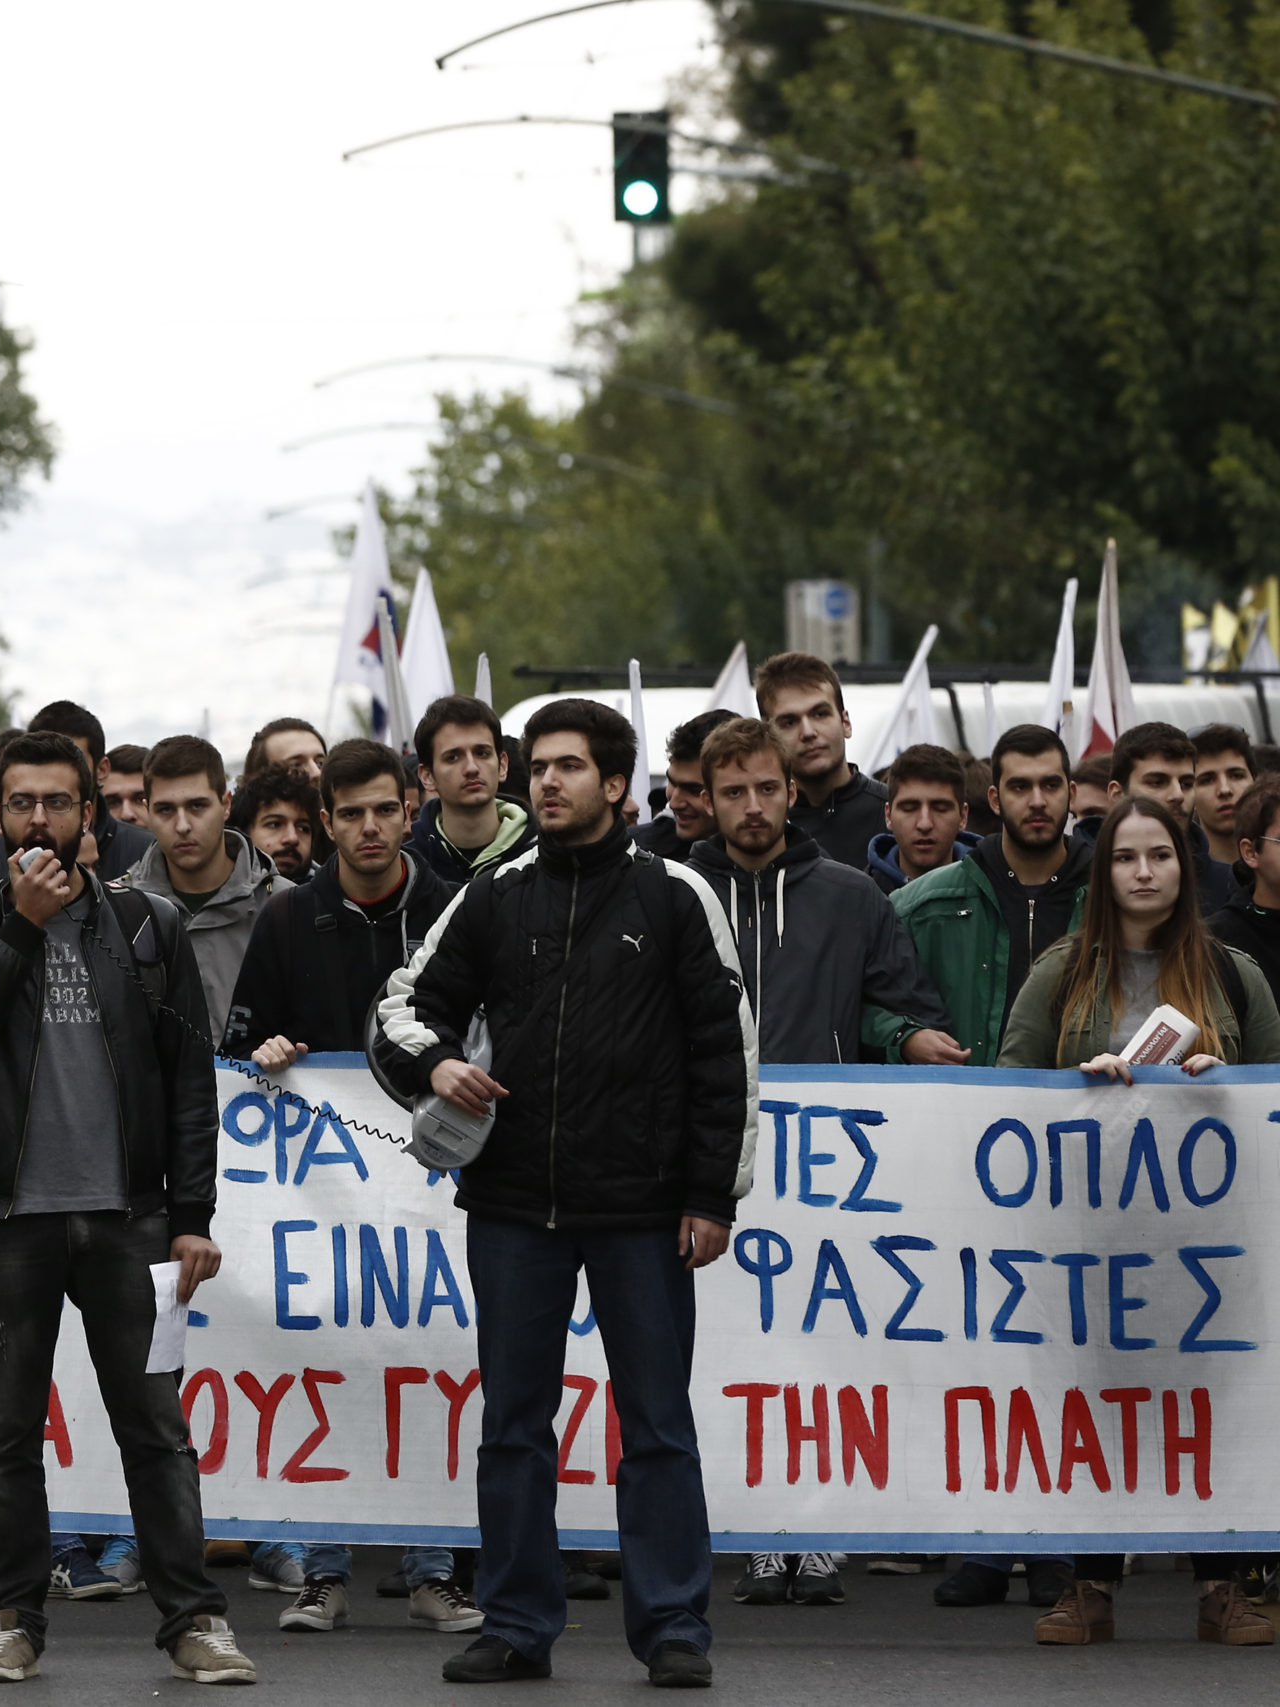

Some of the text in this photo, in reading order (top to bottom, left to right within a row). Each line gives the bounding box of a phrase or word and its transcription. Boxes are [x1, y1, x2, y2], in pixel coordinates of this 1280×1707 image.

[222, 1091, 370, 1187] ΩΡΑ
[751, 1100, 903, 1213] ΤΕΣ
[975, 1117, 1237, 1213] ΟΠΛΟ
[272, 1219, 479, 1331] ΕΙΝΑ
[734, 1227, 1258, 1353] ΦΑΣΙΣΤΕΣ
[181, 1367, 351, 1483] ΟΥΣ
[722, 1381, 889, 1491] ΤΗΝ
[944, 1385, 1213, 1501] ΠΛΑΤΗ
